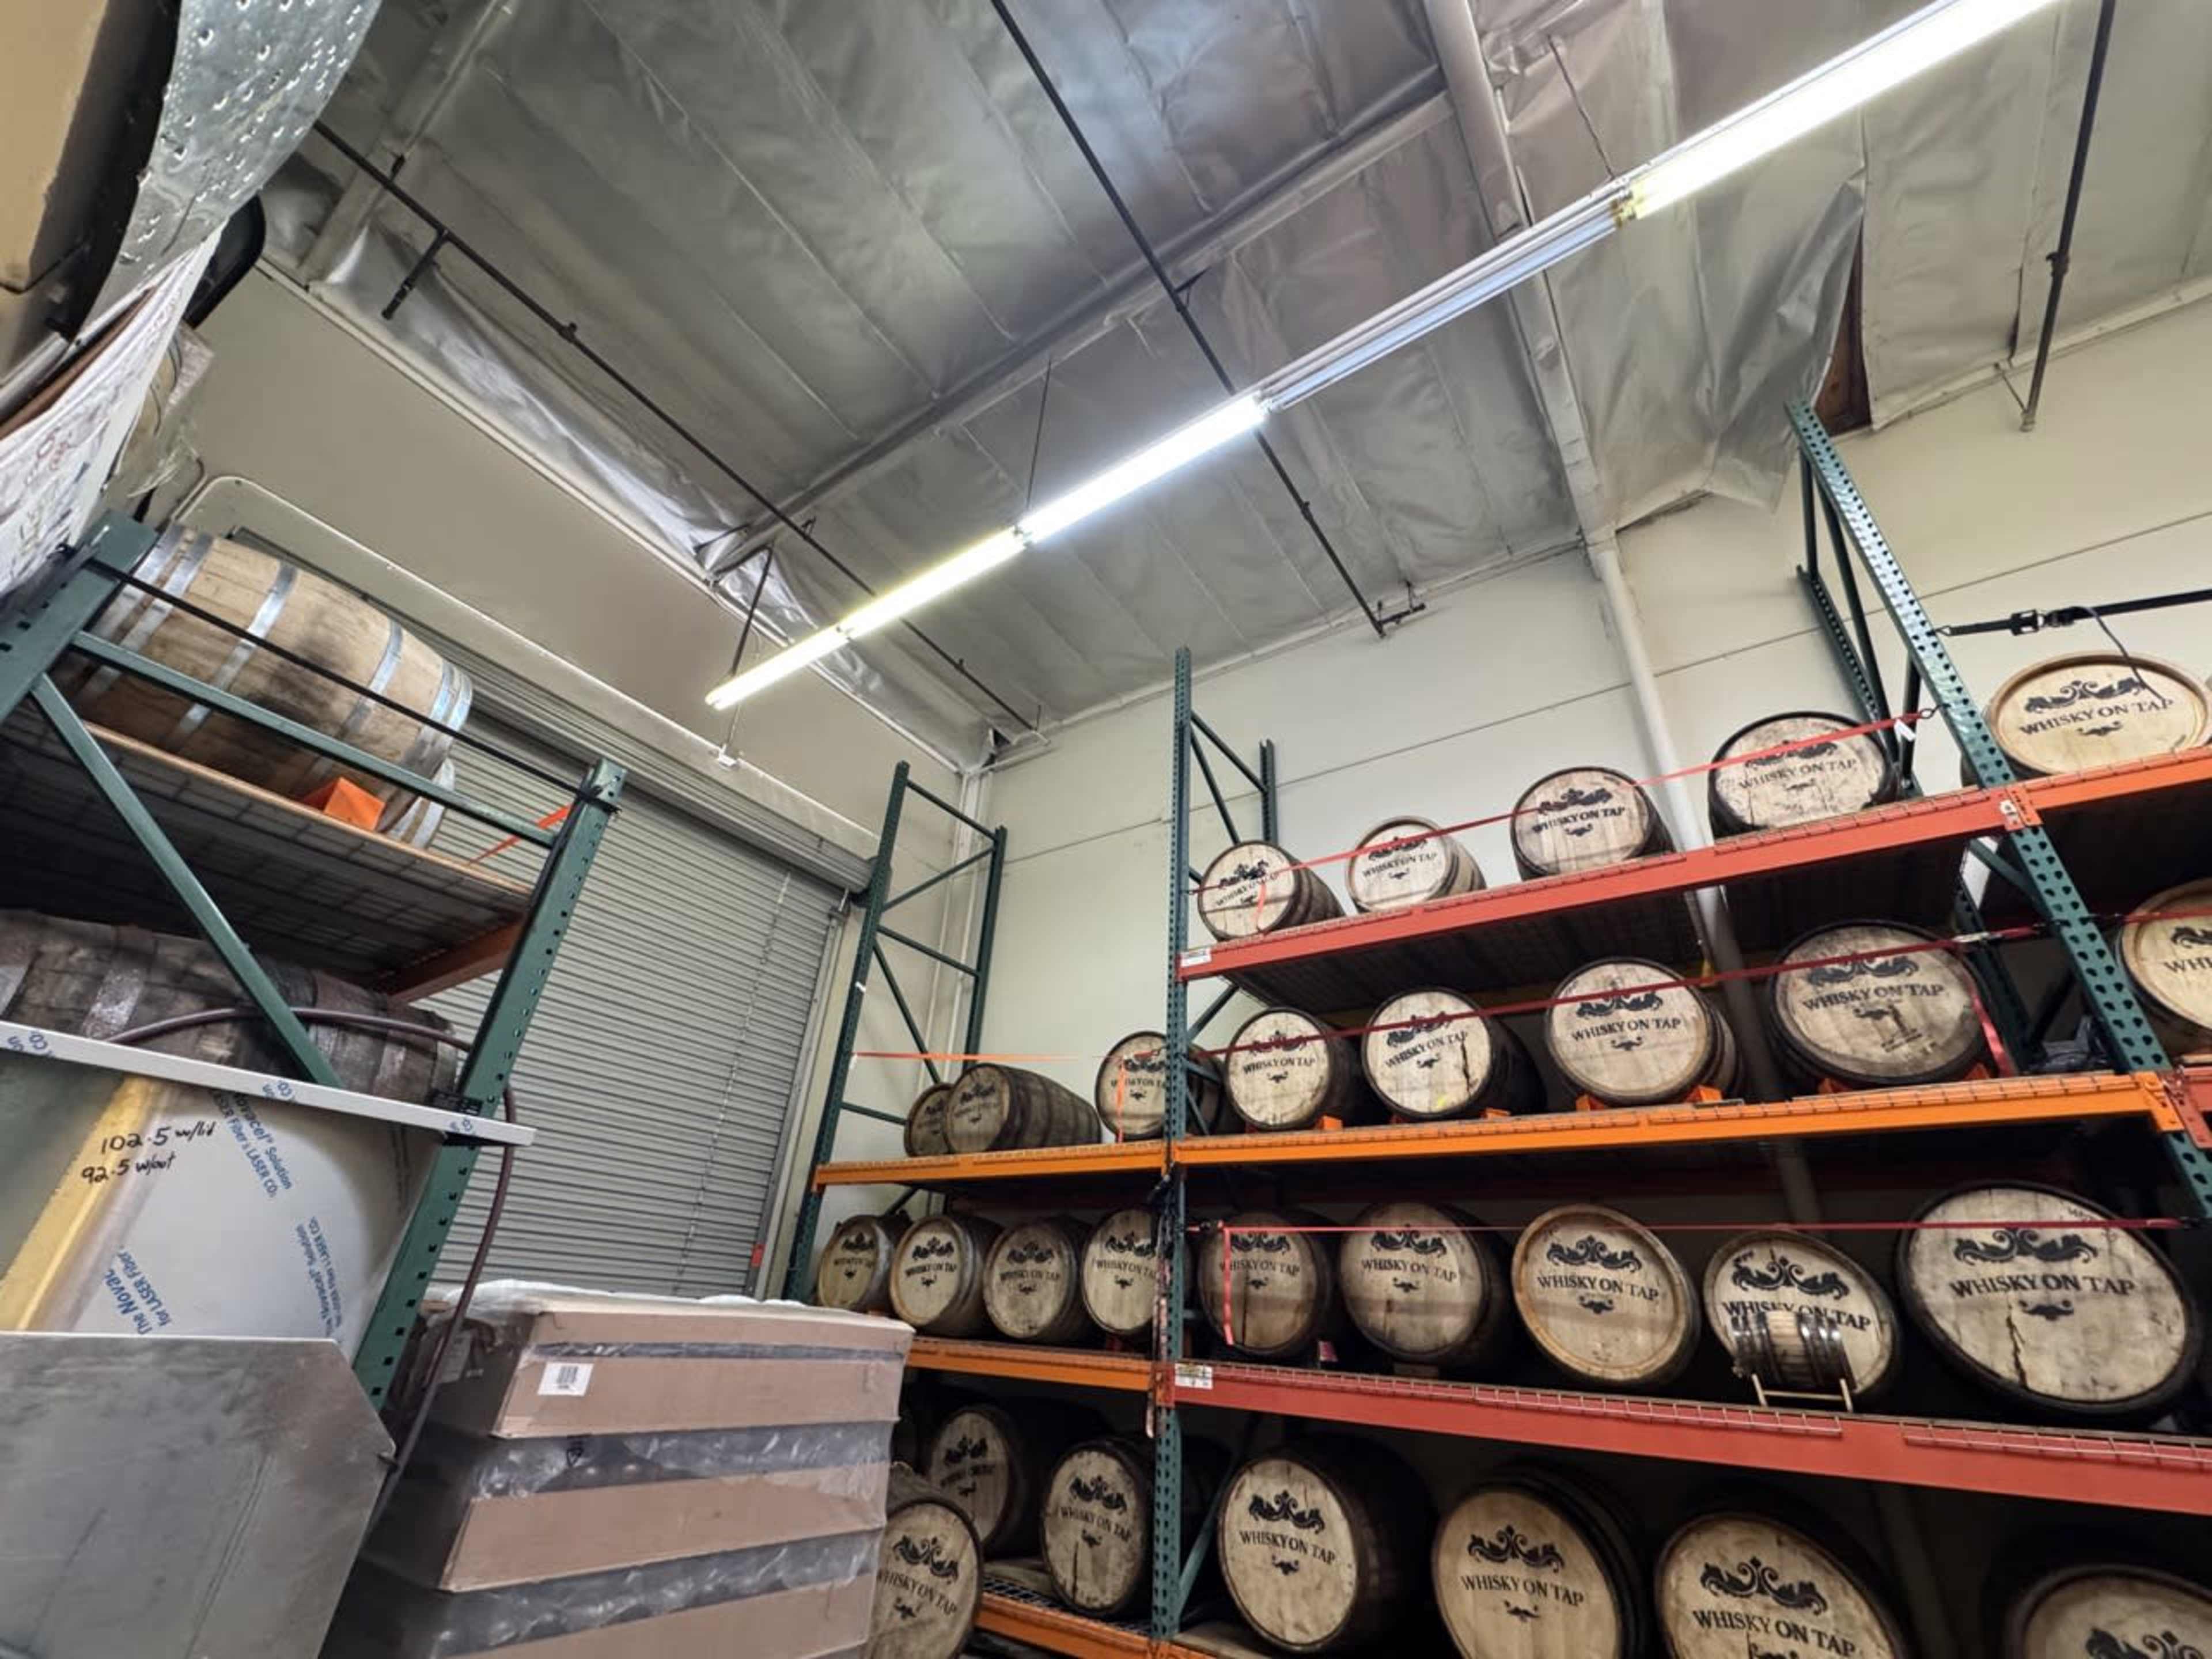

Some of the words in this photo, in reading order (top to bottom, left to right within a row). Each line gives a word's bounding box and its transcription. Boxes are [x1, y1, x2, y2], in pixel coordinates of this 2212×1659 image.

[2019, 710, 2093, 734] WHISKY
[2098, 703, 2129, 717] ON
[2133, 699, 2173, 713] TAP
[1738, 767, 1797, 789] WHISKY
[1800, 763, 1823, 773] ON
[1828, 759, 1857, 770] TAP
[1531, 815, 1578, 833] WHISKY
[1580, 810, 1599, 820] ON
[1603, 807, 1625, 817] TAP
[1801, 988, 1871, 1011] WHISKY
[1874, 986, 1903, 998] ON
[1904, 983, 1944, 996] TAP
[1571, 1021, 1624, 1041] WHISKY
[1627, 1020, 1649, 1031] ON
[1652, 1018, 1681, 1029] TAP
[1243, 1058, 1278, 1074] WHISKY
[1279, 1058, 1294, 1067] ON
[1297, 1057, 1316, 1067] TAP
[1385, 1044, 1425, 1067] WHISKY
[1426, 1037, 1444, 1050] ON
[101, 1126, 171, 1154] 102.5
[82, 1158, 130, 1184] 92.5
[266, 1146, 293, 1190] Solution
[1260, 1259, 1277, 1272] ON
[1280, 1263, 1300, 1277] TAP
[1361, 1259, 1407, 1271] WHISKY
[1410, 1262, 1429, 1275] ON
[1433, 1267, 1458, 1282] TAP
[1537, 1275, 1597, 1290] WHISKY
[1599, 1278, 1623, 1293] ON
[1626, 1284, 1659, 1301] TAP
[1949, 1274, 2037, 1298] WHISKY
[2040, 1273, 2081, 1291] ON
[2082, 1276, 2135, 1296] TAP
[1831, 1309, 1871, 1331] TAP
[1060, 1506, 1094, 1522] WHISKY
[1097, 1516, 1111, 1532] ON
[1114, 1523, 1131, 1542] TAP
[1240, 1531, 1289, 1548] WHISKY
[1289, 1537, 1308, 1554] ON
[1312, 1544, 1335, 1565] TAP
[917, 1582, 934, 1602] ON
[935, 1592, 957, 1615] TAP
[1461, 1575, 1521, 1591] WHISKY
[1523, 1579, 1548, 1597] ON
[1551, 1583, 1584, 1607] TAP
[1692, 1610, 1770, 1634] WHISKY
[1775, 1619, 1809, 1644] ON
[1810, 1628, 1856, 1657] TAP
